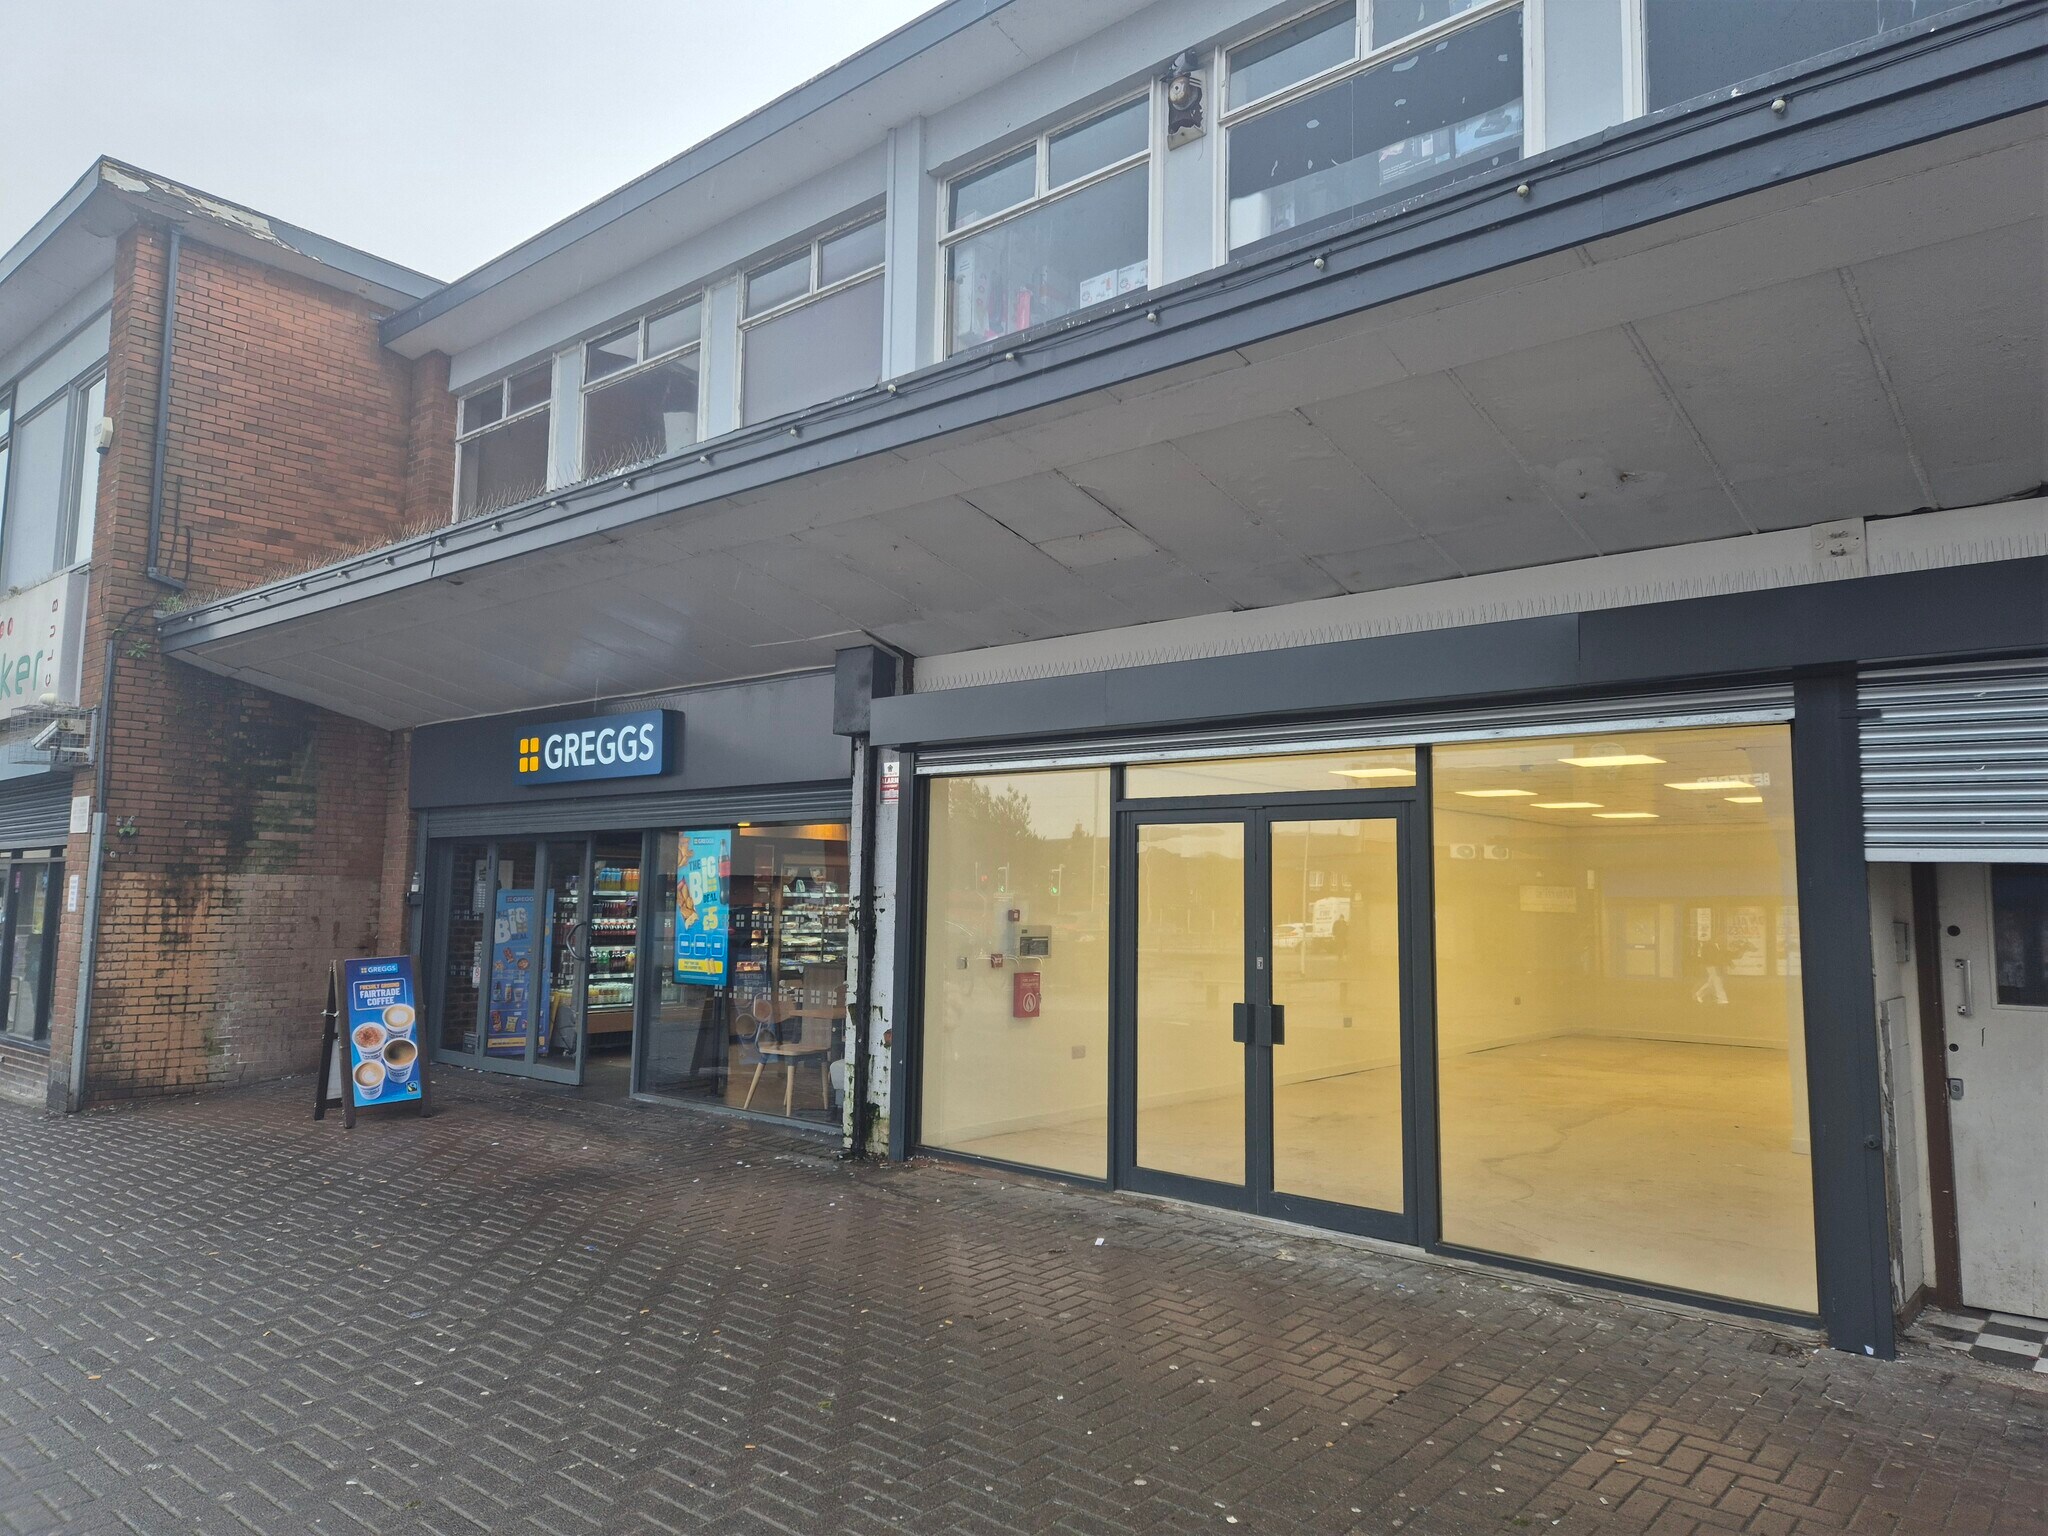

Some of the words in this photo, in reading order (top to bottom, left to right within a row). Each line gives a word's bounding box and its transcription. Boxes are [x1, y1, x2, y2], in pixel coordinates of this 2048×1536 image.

[544, 723, 654, 770] GREGGS
[367, 965, 397, 974] GREGGS
[360, 988, 401, 999] FAIRTRADE
[367, 996, 395, 1006] COFFEE
